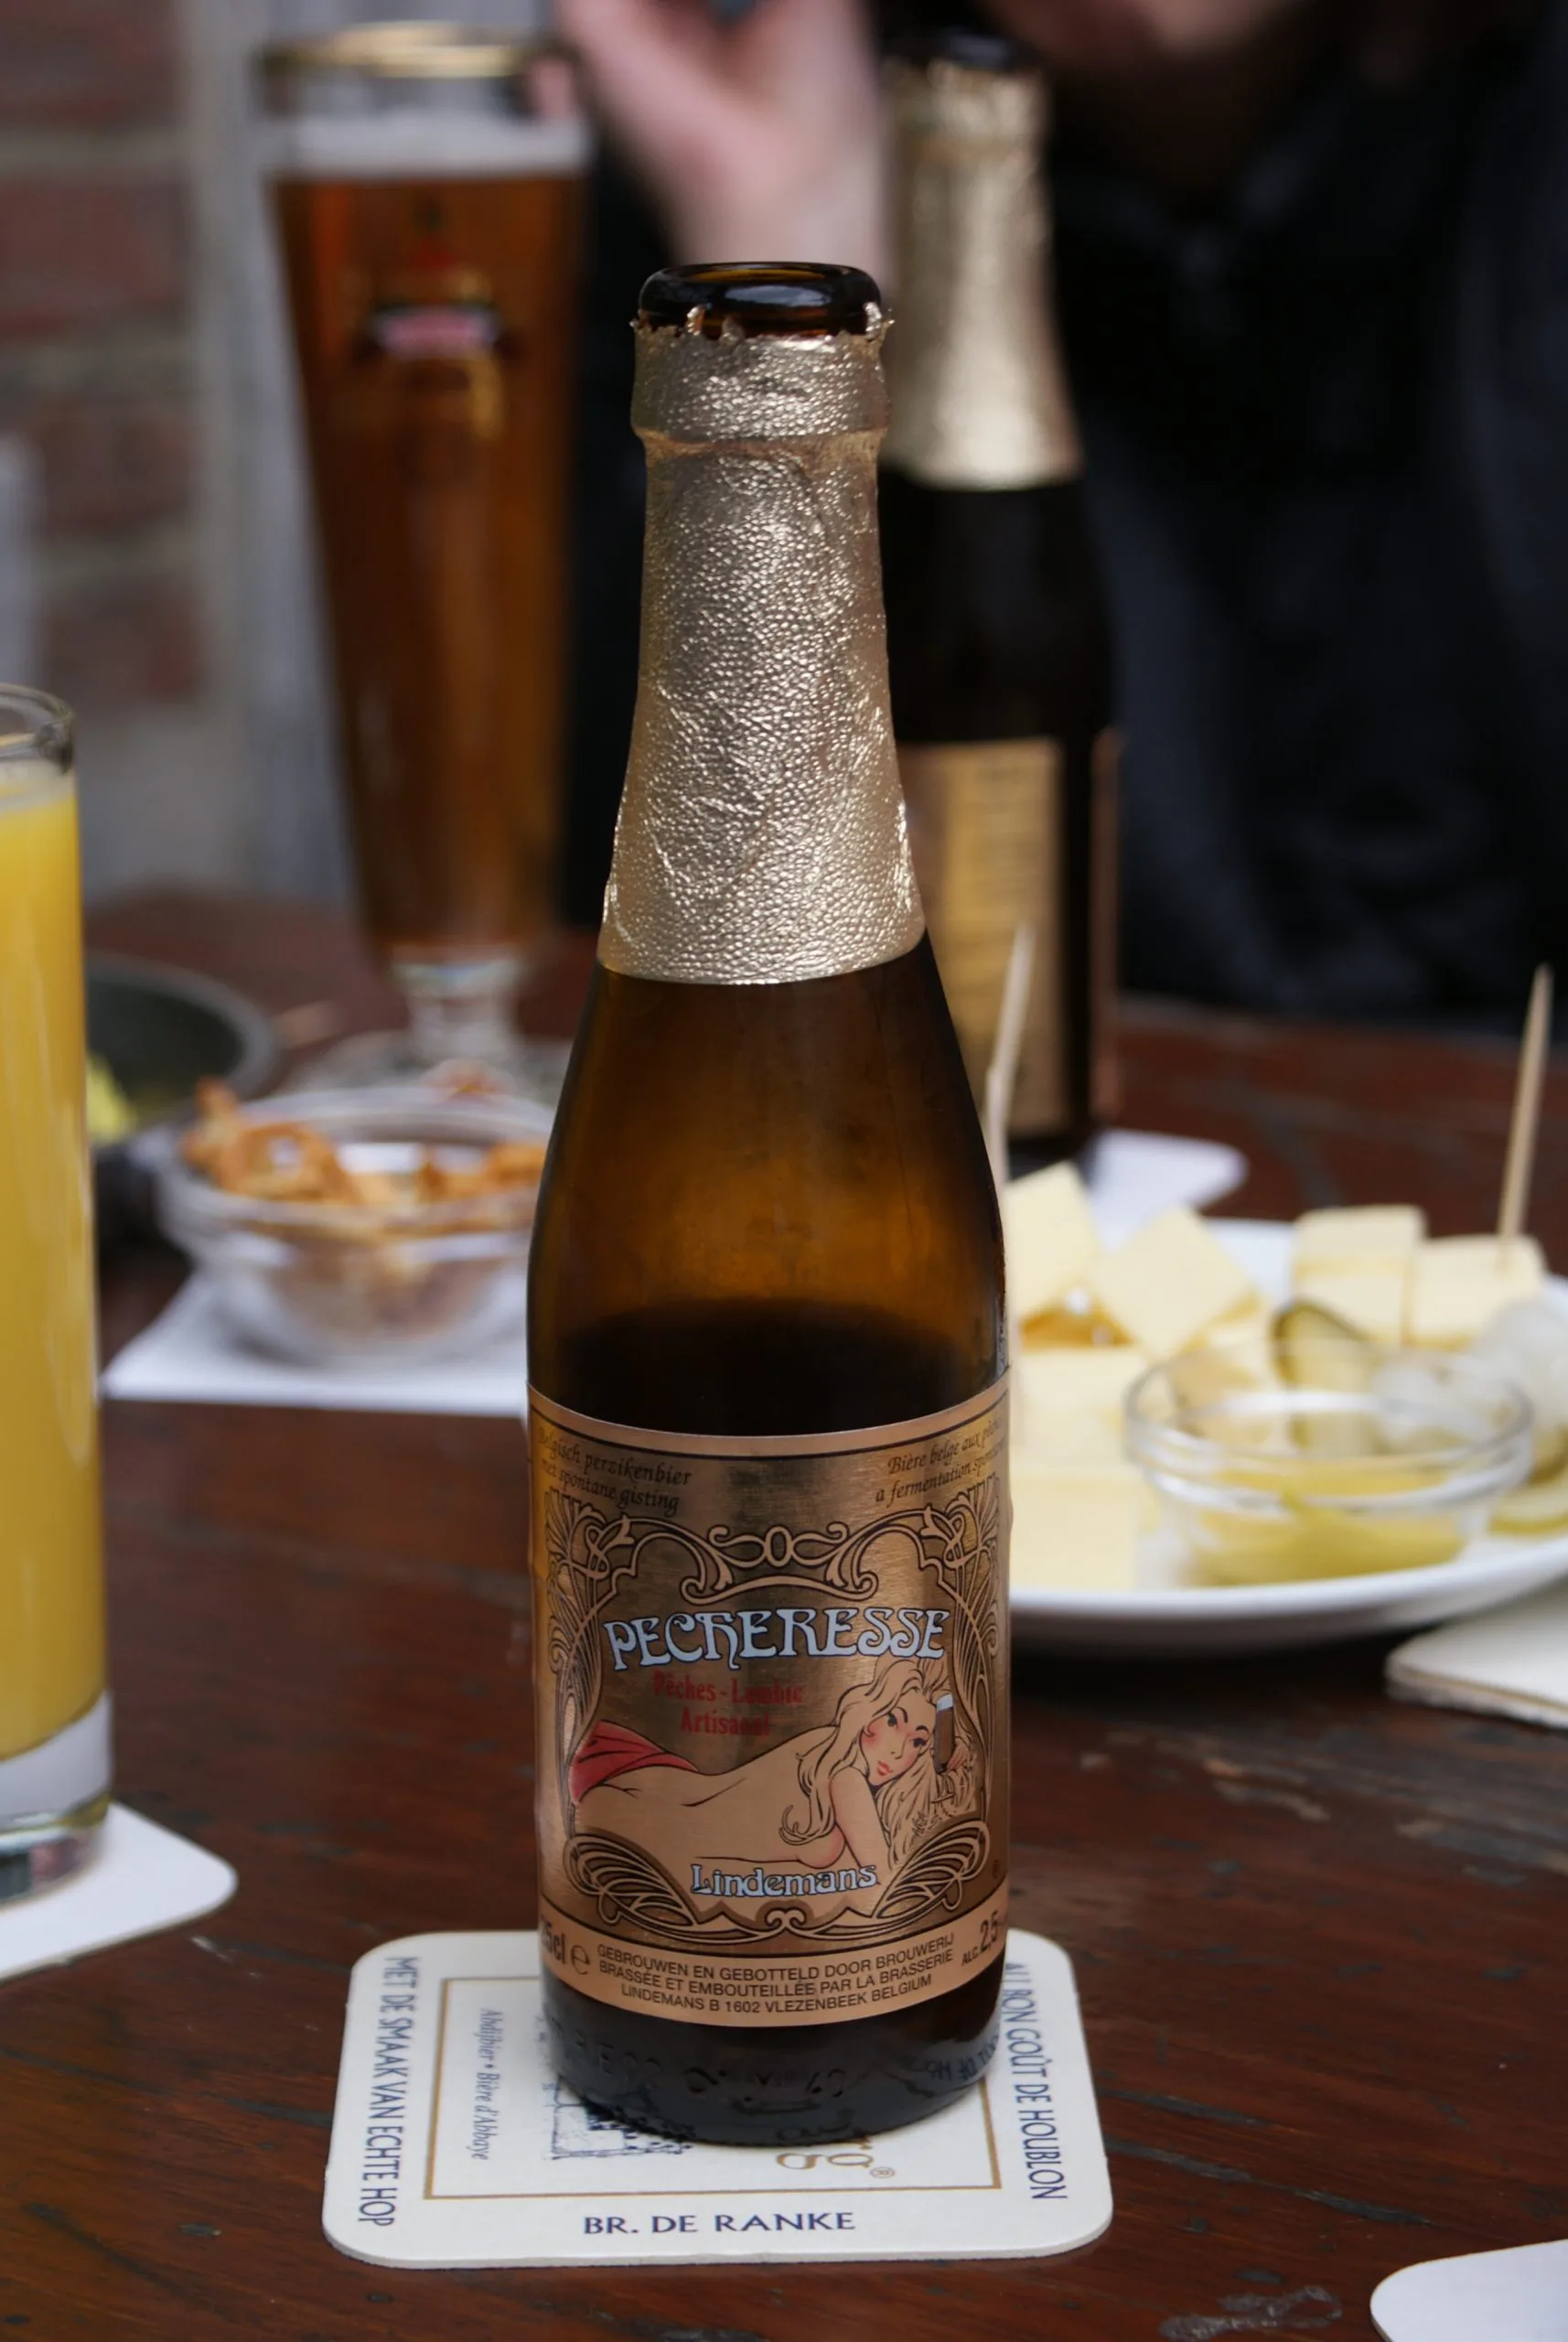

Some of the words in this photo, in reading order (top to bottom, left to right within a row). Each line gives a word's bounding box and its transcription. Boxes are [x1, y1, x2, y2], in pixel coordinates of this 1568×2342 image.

[584, 1453, 693, 1486] perzikenbier
[887, 1451, 927, 1475] Bière
[930, 1440, 960, 1465] belge
[961, 1431, 980, 1451] aux
[559, 1469, 617, 1500] spontane
[617, 1485, 681, 1518] gisting
[886, 1462, 971, 1508] fermentation
[603, 1606, 950, 1671] PECHERESSE
[682, 1706, 770, 1736] Artisanal
[691, 1864, 878, 1897] Lindemans
[383, 1956, 418, 1989] MET
[597, 1943, 688, 1976] GEBROUWEN
[693, 1965, 714, 1980] EN
[719, 1966, 820, 1982] GEBOTTELD
[824, 1960, 872, 1978] DOOR
[875, 1933, 954, 1969] BROUWERIJ
[599, 1961, 660, 1988] BRASSÉE
[665, 1978, 683, 1992] ET
[688, 1980, 817, 1997] EMBOUTEILLÉE
[820, 1979, 853, 1995] PAR
[856, 1975, 876, 1990] LA
[880, 1950, 954, 1983] BRASSERIE
[379, 1994, 416, 2013] DE
[620, 1983, 704, 2011] LINDEMANS
[709, 1999, 720, 2012] B
[725, 2001, 761, 2014] 1602
[765, 1991, 868, 2014] VLEZENBEEK
[871, 1973, 933, 2003] BELGIUM
[1001, 1989, 1038, 2023] BON
[372, 2017, 413, 2079] SMAAK
[473, 2008, 504, 2061] Abdijbier
[1005, 2027, 1053, 2078] GOÛT
[368, 2080, 408, 2120] VAN
[475, 2071, 501, 2103] Bière
[1014, 2083, 1052, 2104] DE
[361, 2125, 403, 2182] ECHTE
[465, 2104, 499, 2161] d'Abbaye
[1018, 2110, 1069, 2199] HOUBLON
[358, 2187, 398, 2227] HOP
[583, 2216, 639, 2235] BR.
[650, 2214, 698, 2233] DE
[714, 2211, 856, 2233] RANKE
